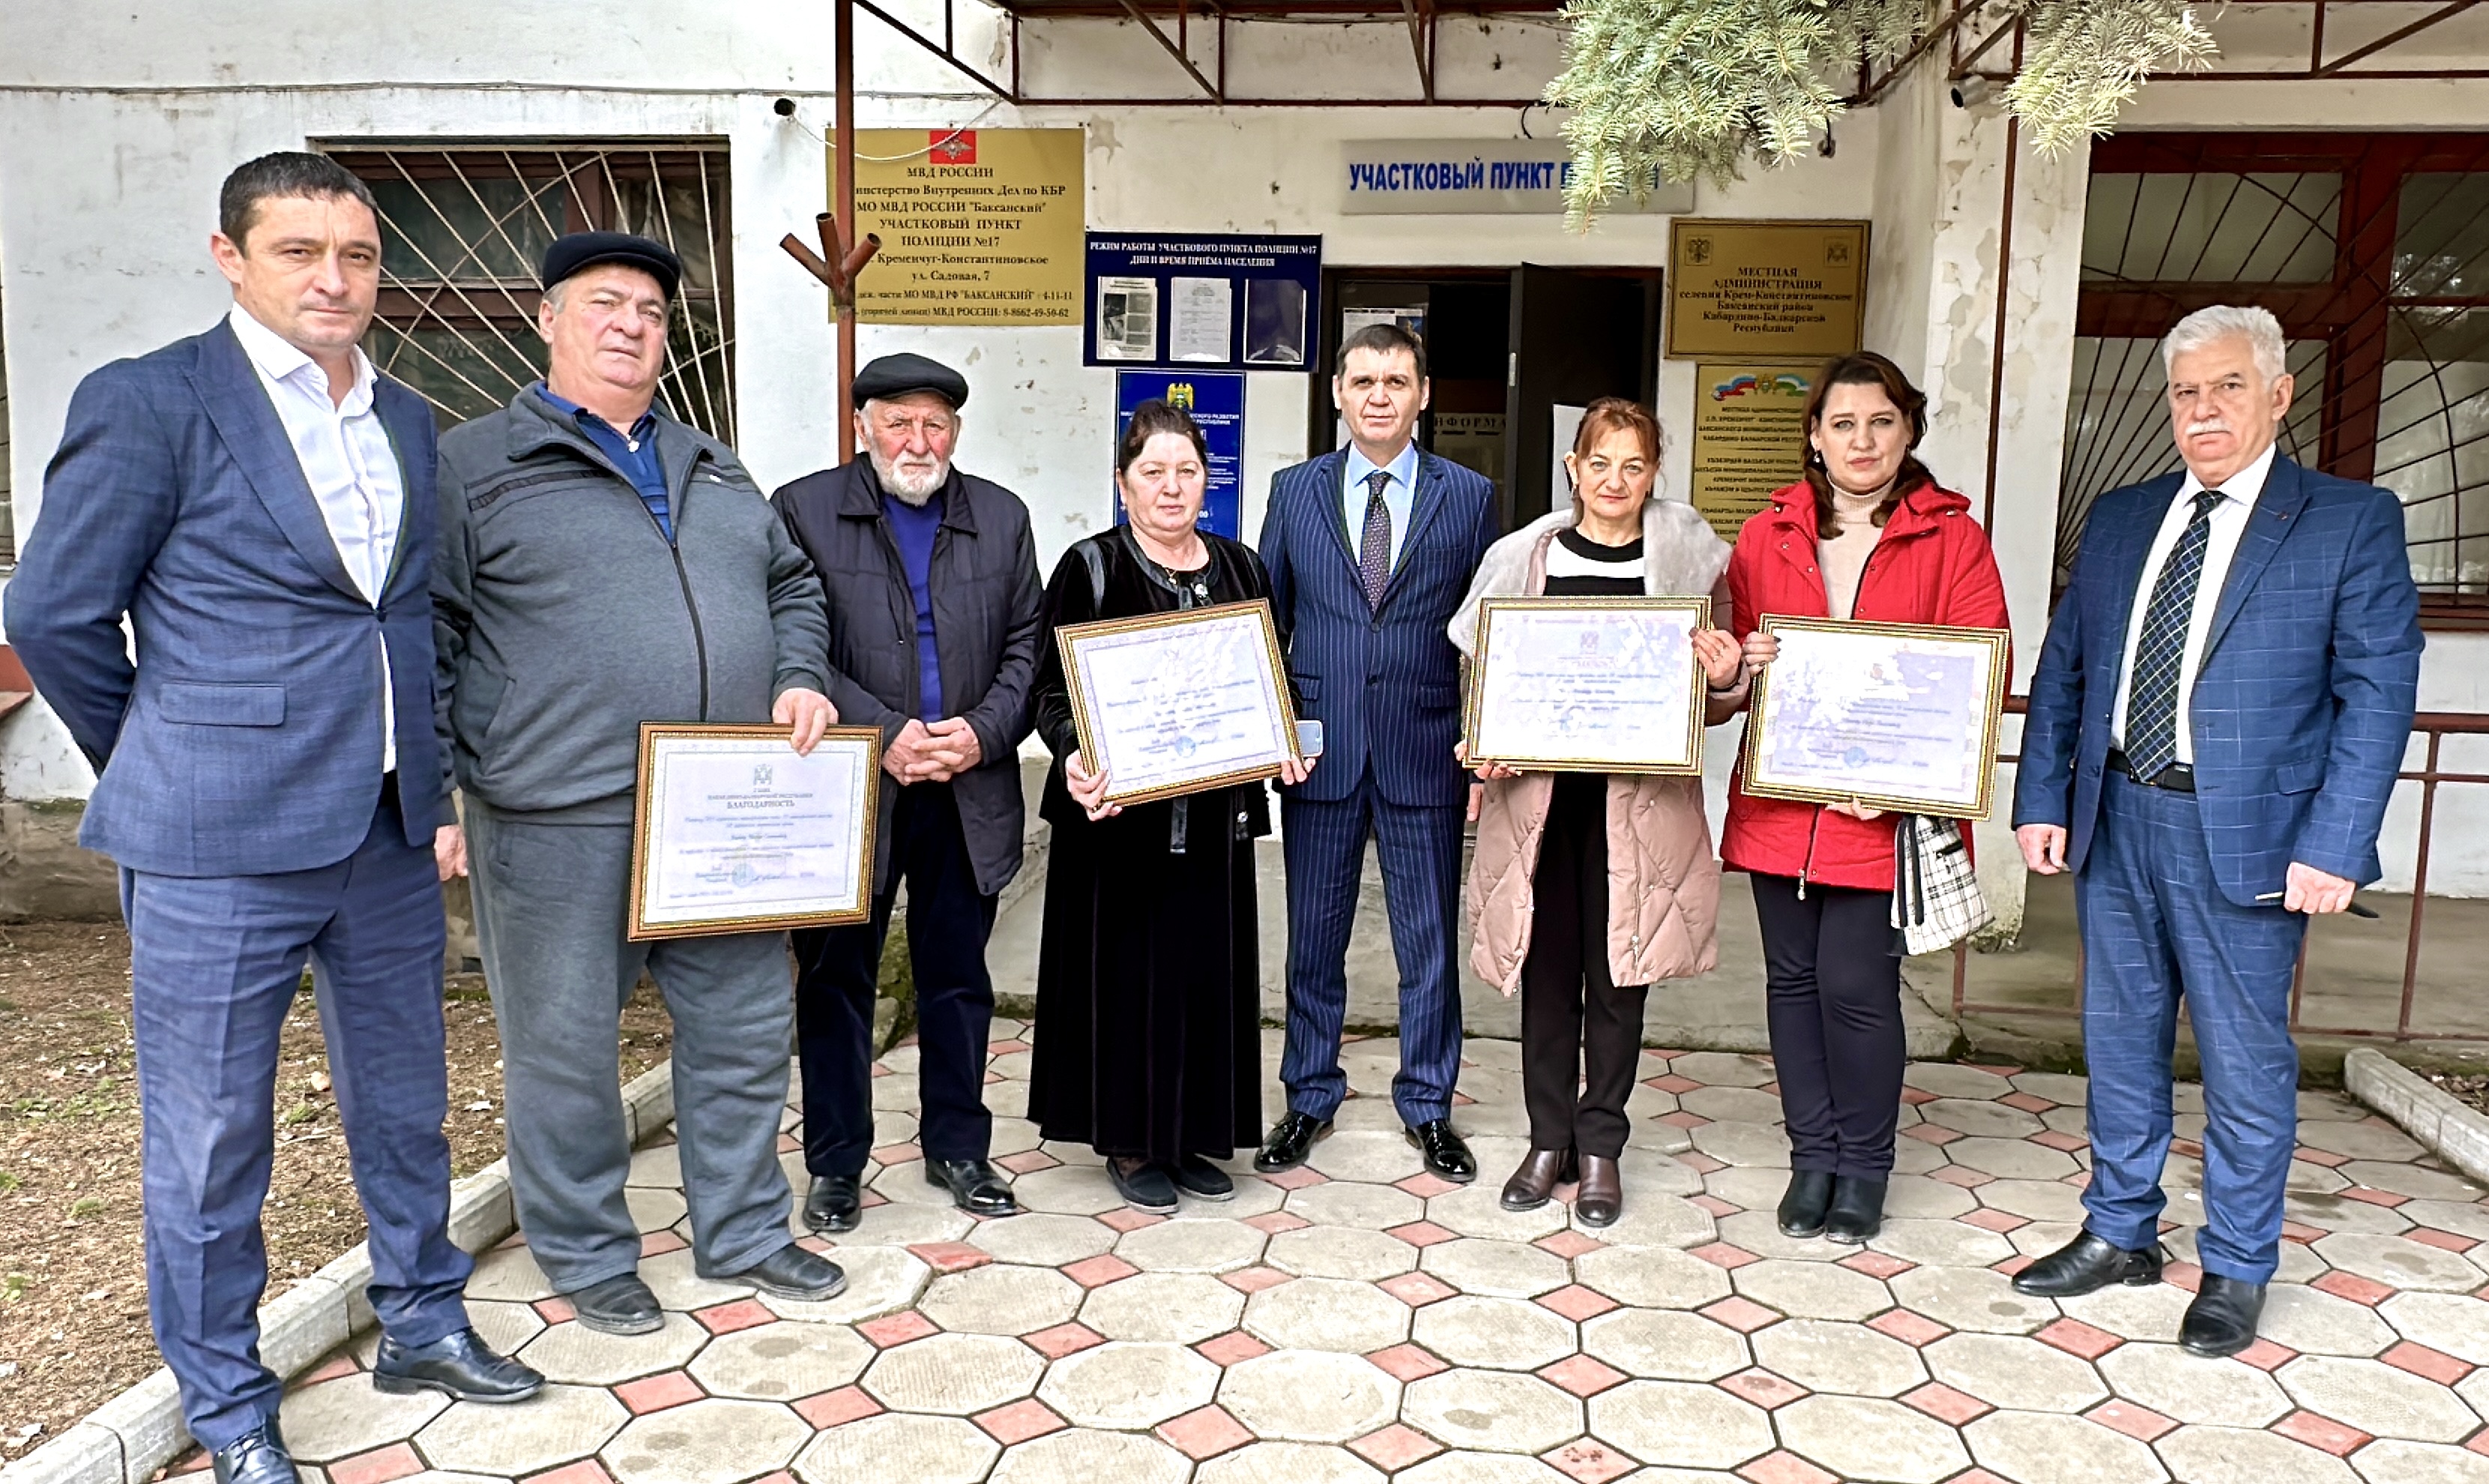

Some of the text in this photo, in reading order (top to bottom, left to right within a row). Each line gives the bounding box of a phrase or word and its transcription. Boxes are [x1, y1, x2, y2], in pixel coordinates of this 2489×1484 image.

[907, 166, 994, 178] МВД РОССИИ
[1349, 156, 1484, 191] УЧАСТКОВЫЙ
[1490, 161, 1554, 190] ПУНКТ
[856, 184, 1067, 198] нистерство Внутренних Дел по КБР
[857, 201, 877, 212] МО
[880, 201, 908, 213] МВД
[911, 201, 966, 212] РОССИИ
[879, 217, 1022, 229] УЧАСТКОВЫЙ ПУНКТ
[901, 236, 1000, 247] ПОЛИЦИИ №17
[1090, 241, 1120, 250] РЕЖИМ
[1121, 242, 1156, 251] РАБОТЫ
[1158, 243, 1219, 252] УЧАСТКОВОГО
[1219, 244, 1254, 253] ПУНКТА
[1255, 244, 1298, 254] ПОЛИЦИИ
[1129, 255, 1150, 265] ДНИ
[1159, 256, 1186, 265] ВРЕМЯ
[1224, 256, 1275, 267] НАСЕЛЕНИЯ
[912, 270, 990, 283] ул. Садовая, 7
[1738, 267, 1798, 277] МЕСТНАЯ
[1713, 279, 1823, 290] АДМИНИСТРАЦИЯ
[904, 289, 919, 299] МО
[922, 289, 944, 300] МВД
